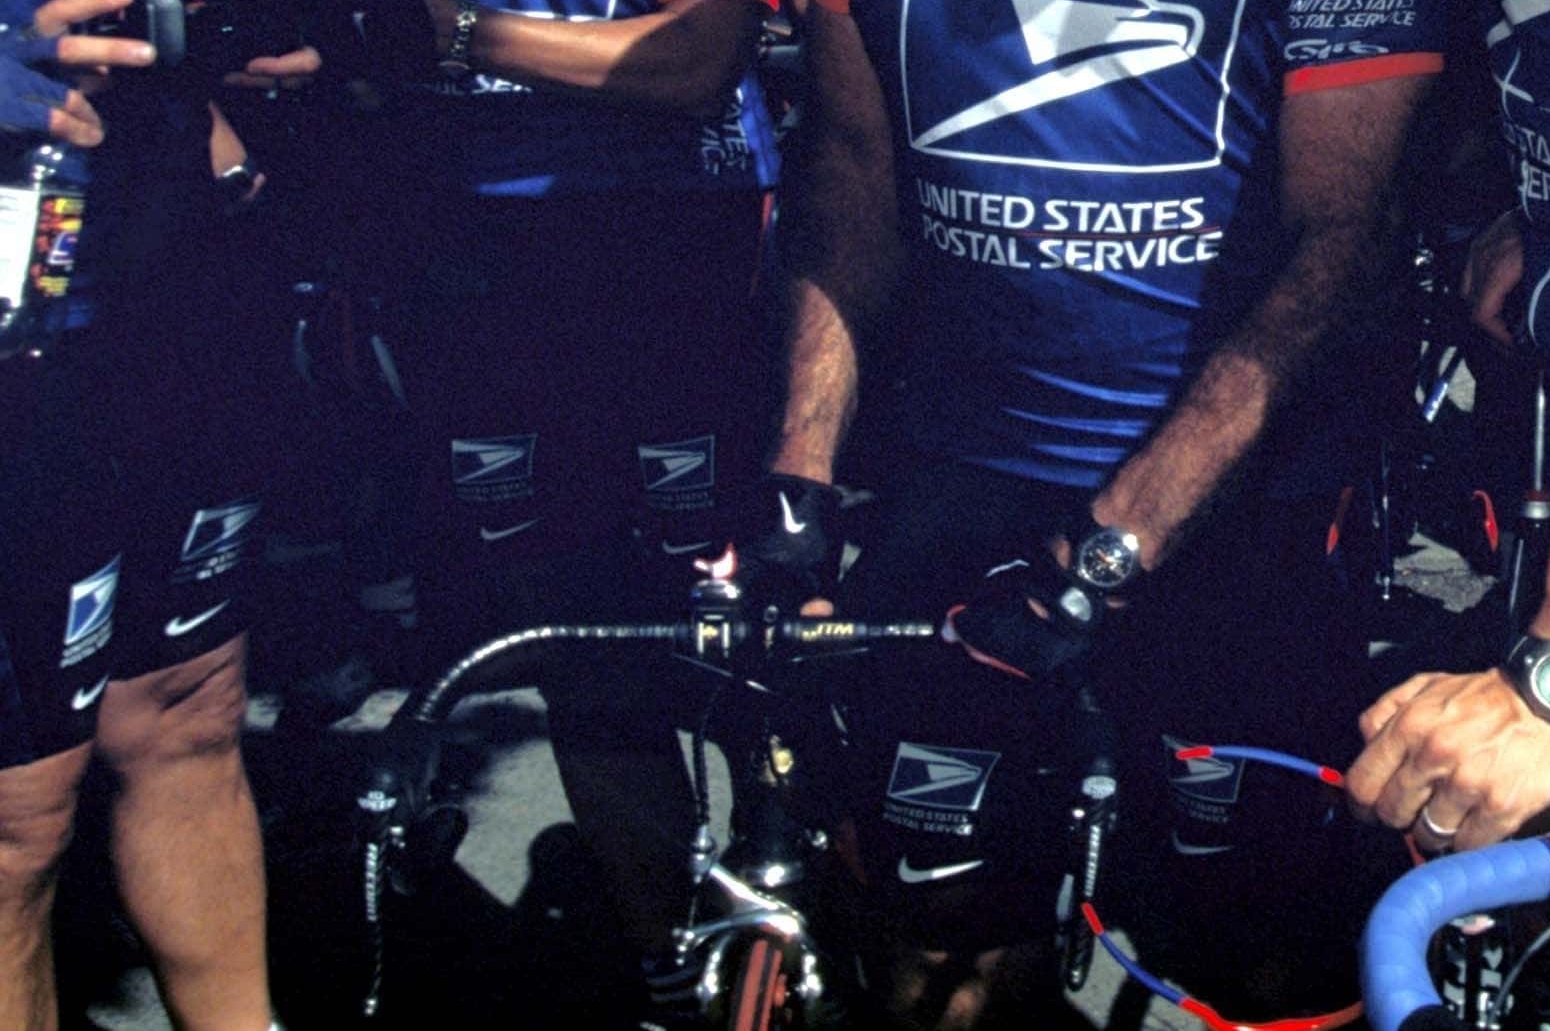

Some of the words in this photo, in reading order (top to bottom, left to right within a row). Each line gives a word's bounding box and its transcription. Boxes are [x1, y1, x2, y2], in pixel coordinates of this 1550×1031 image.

[916, 178, 1036, 229] UNITED
[1043, 197, 1204, 233] STATES
[922, 214, 1031, 269] POSTAL
[1037, 231, 1223, 272] SERVICE
